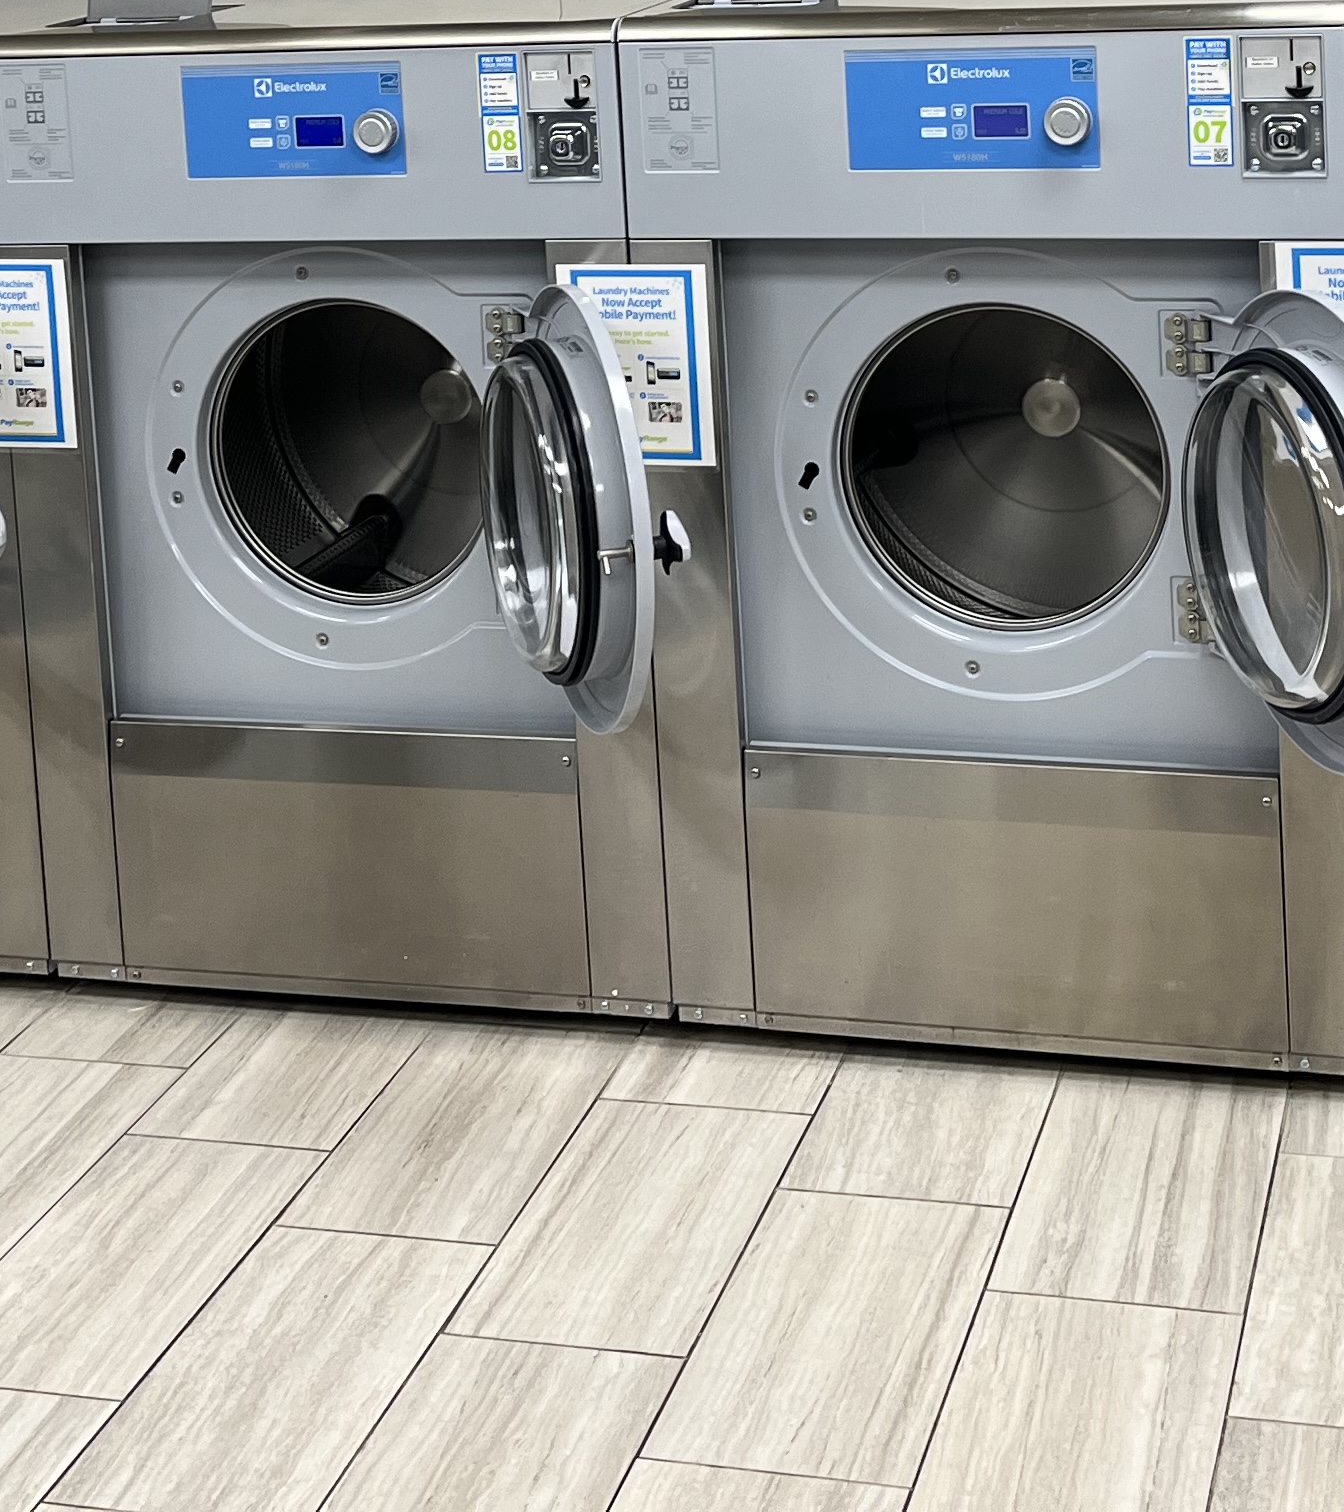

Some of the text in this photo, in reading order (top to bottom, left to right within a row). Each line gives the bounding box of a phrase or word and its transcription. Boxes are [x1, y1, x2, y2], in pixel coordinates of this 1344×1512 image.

[1189, 40, 1227, 48] PAY WITH
[950, 67, 1010, 78] Electrolux
[274, 81, 327, 92] Electrolux
[1193, 120, 1227, 143] 07
[487, 129, 517, 151] 08
[593, 287, 670, 297] Laundry Machines
[601, 297, 662, 309] Now Accept
[626, 310, 676, 322] Payment!
